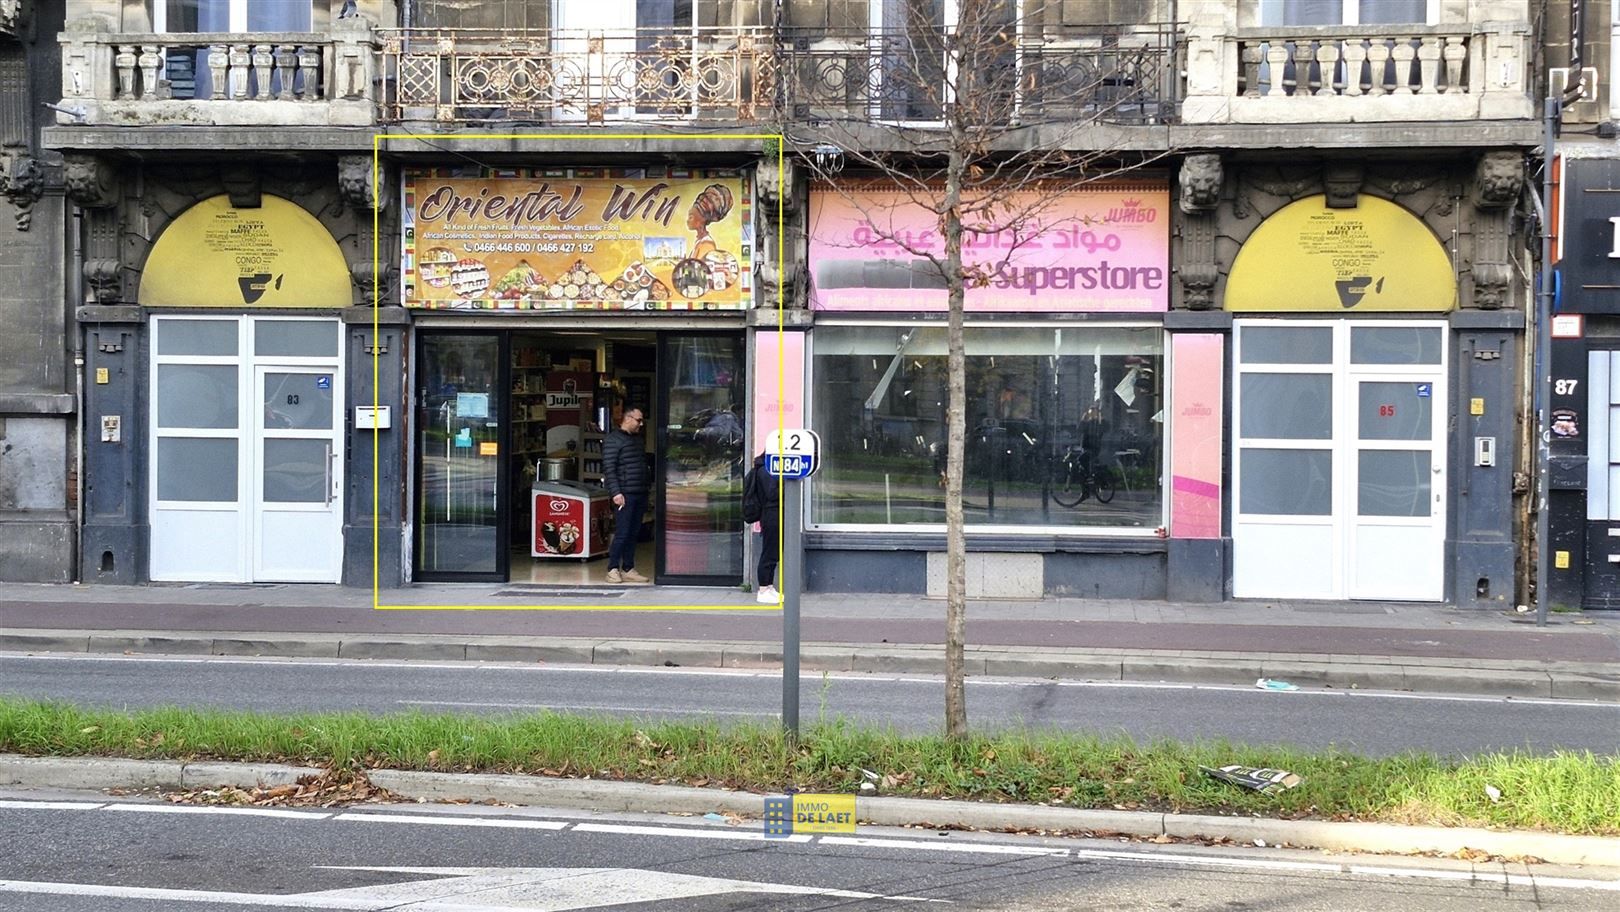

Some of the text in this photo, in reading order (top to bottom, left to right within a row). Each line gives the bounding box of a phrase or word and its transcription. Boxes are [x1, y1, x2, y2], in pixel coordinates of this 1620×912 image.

[419, 182, 681, 227] Oriental Win
[1104, 207, 1156, 222] JUMBO
[1052, 224, 1121, 254] مواد
[474, 243, 495, 252] 0466
[497, 243, 513, 252] 446
[514, 243, 531, 252] 600
[537, 243, 559, 252] 0466
[560, 243, 576, 252] 427
[578, 243, 594, 252] 192
[235, 256, 262, 265] CONGO
[1332, 258, 1361, 267] CONGO
[995, 260, 1162, 295] Superstore
[1555, 379, 1578, 395] 87
[287, 394, 299, 405] 83
[1380, 405, 1395, 417] 85
